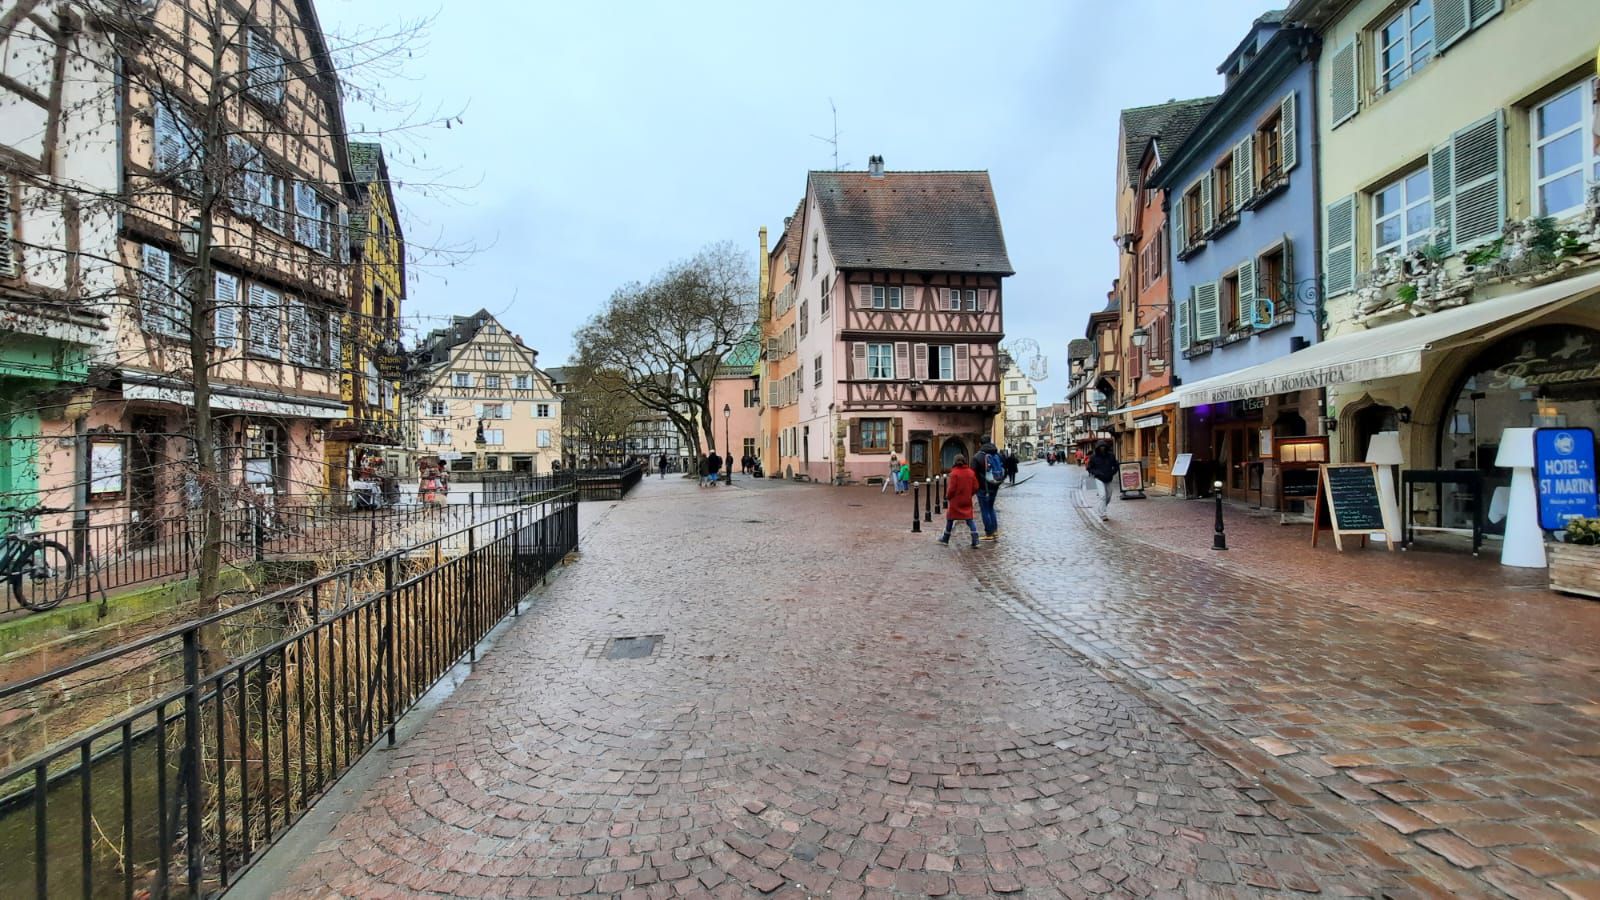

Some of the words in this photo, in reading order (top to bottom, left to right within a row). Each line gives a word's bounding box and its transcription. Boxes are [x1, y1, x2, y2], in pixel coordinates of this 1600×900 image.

[1264, 382, 1275, 394] LA
[1281, 370, 1344, 391] ROMANTICA
[1545, 459, 1580, 475] HOTEL
[1540, 479, 1551, 494] ST
[1555, 479, 1594, 494] MARTIN
